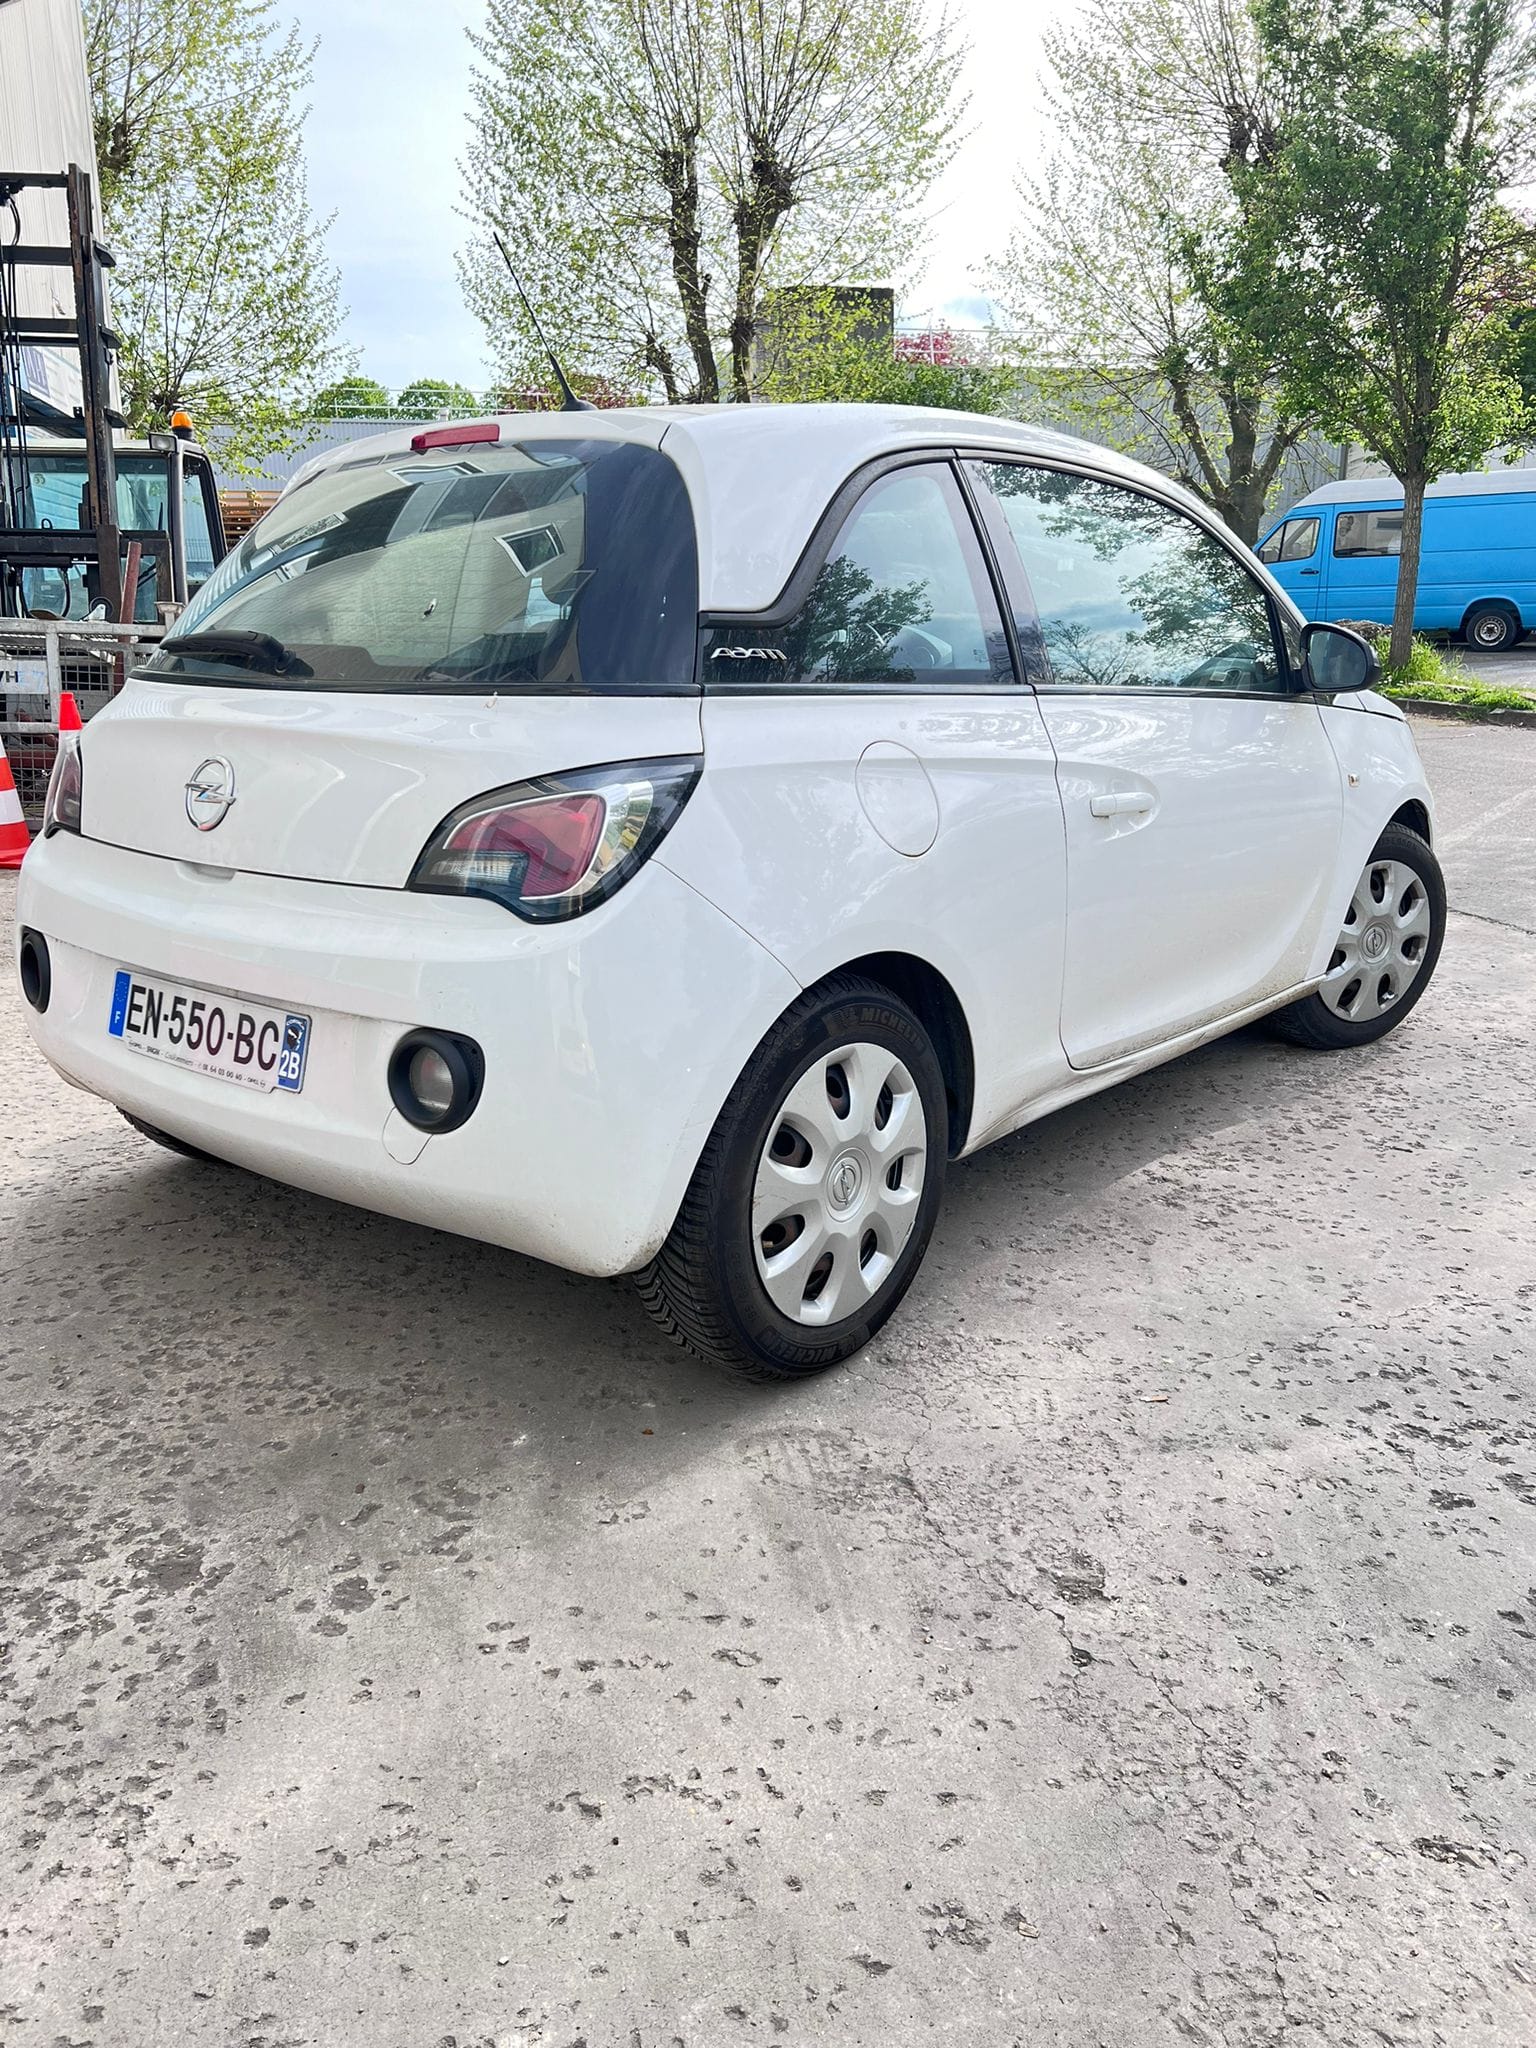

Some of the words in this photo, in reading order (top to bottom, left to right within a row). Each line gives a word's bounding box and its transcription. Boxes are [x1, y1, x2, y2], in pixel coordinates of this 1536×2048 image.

[710, 646, 788, 661] ADAM
[126, 984, 279, 1071] EN-550-BC
[860, 1007, 924, 1049] MICHELIN
[278, 1049, 301, 1080] 2B
[759, 1333, 837, 1363] MICHELIN
